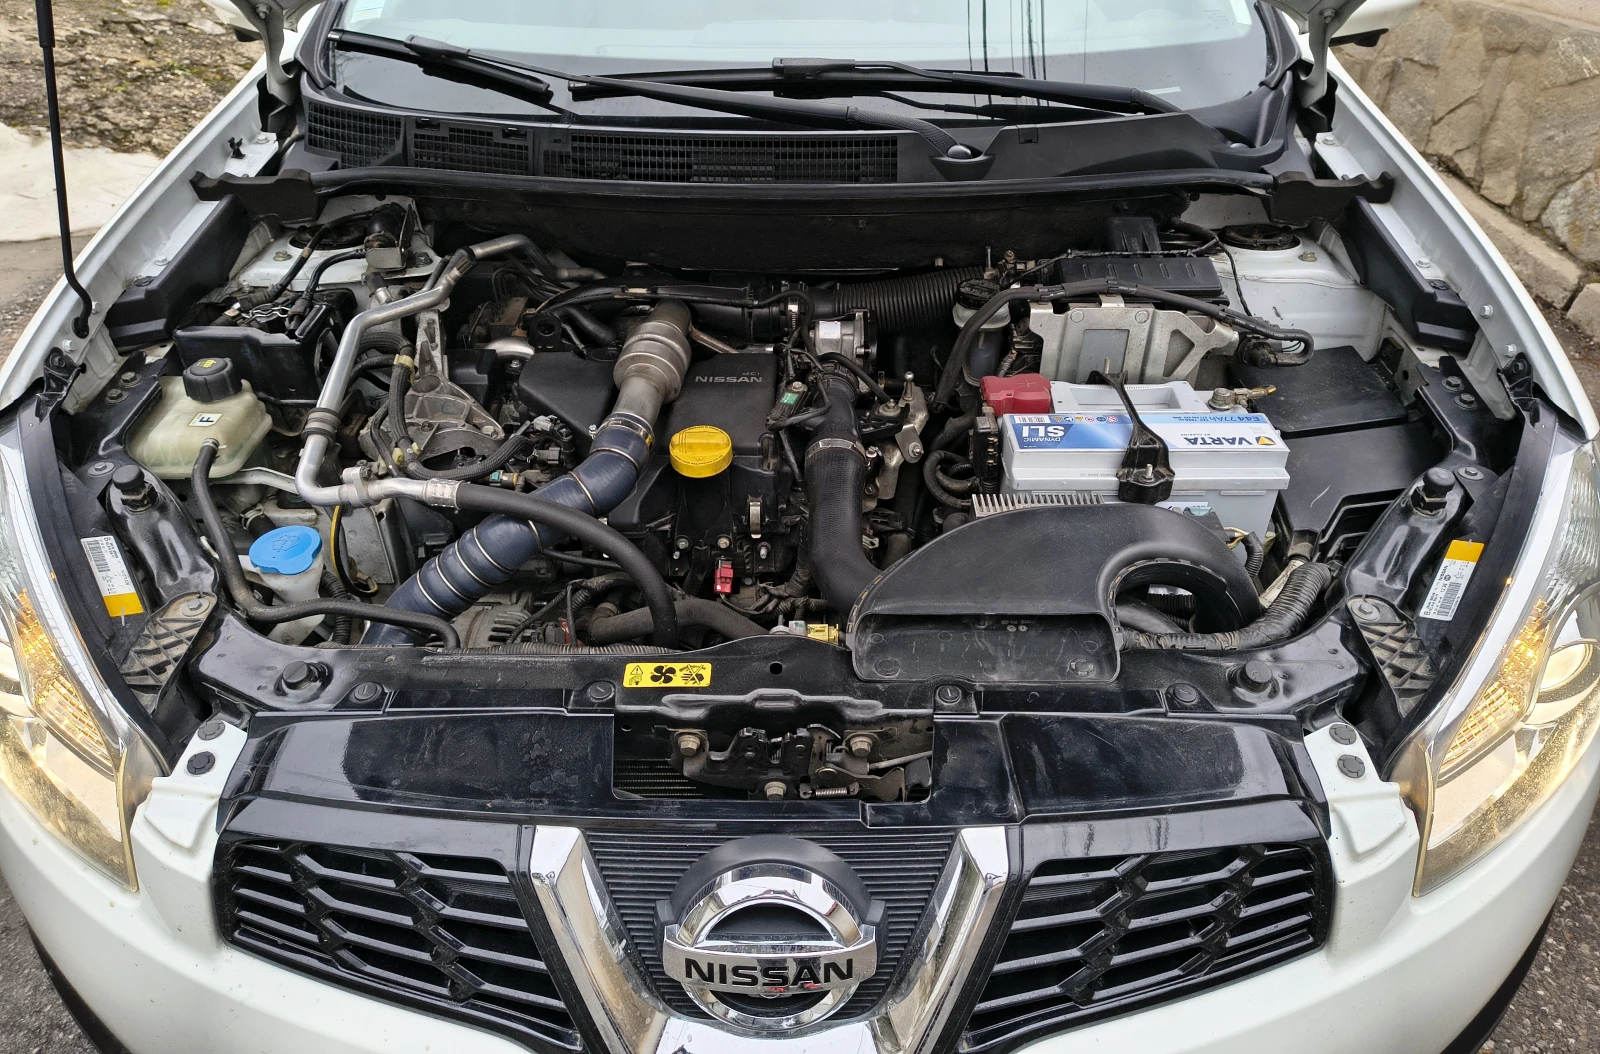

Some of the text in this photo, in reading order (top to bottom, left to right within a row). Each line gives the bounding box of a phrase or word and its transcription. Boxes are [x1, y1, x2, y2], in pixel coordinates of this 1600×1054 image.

[1022, 425, 1065, 437] SLI
[1183, 437, 1254, 446] VARTA
[684, 957, 854, 987] NISSAN
